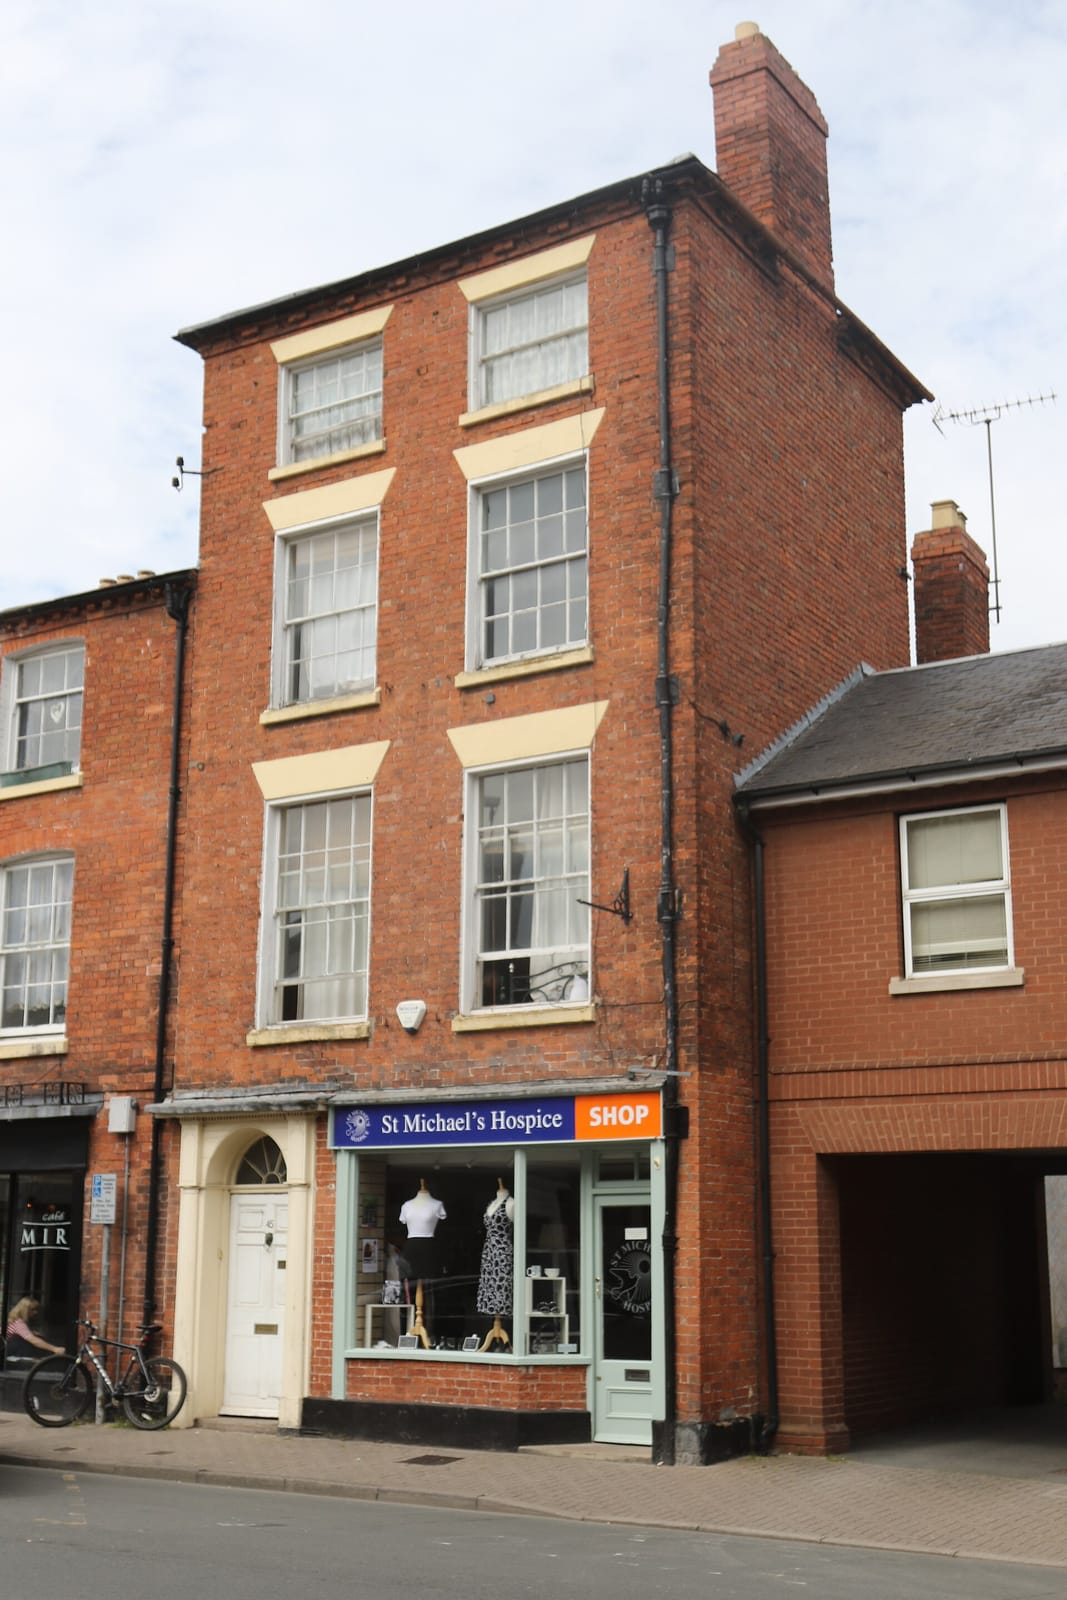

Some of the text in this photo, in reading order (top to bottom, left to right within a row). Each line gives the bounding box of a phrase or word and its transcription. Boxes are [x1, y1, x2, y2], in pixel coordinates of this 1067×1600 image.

[381, 1115, 398, 1134] St
[403, 1112, 485, 1133] Michael's
[490, 1109, 563, 1134] Hospice
[589, 1105, 649, 1127] SHOP
[21, 1228, 67, 1245] MIR
